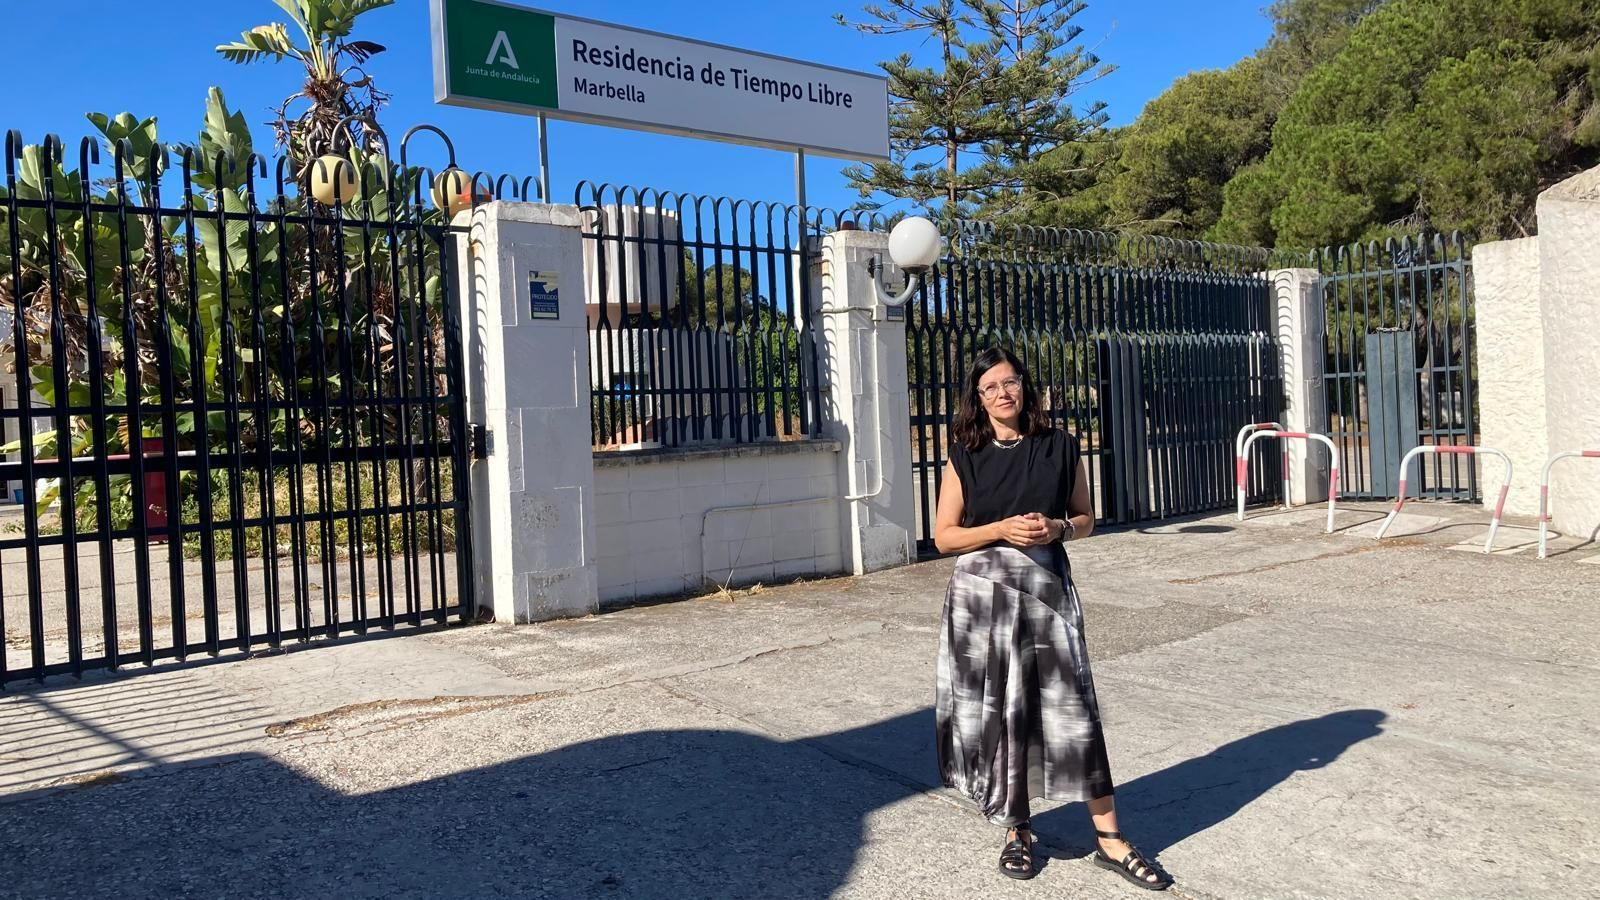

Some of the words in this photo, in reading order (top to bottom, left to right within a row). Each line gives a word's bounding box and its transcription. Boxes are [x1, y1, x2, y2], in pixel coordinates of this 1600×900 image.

[465, 65, 489, 77] Junta
[490, 69, 501, 78] de
[572, 39, 695, 82] Residencia
[700, 62, 725, 87] de
[730, 68, 803, 103] Tiempo
[808, 82, 853, 109] Libre
[574, 77, 646, 103] Marbella
